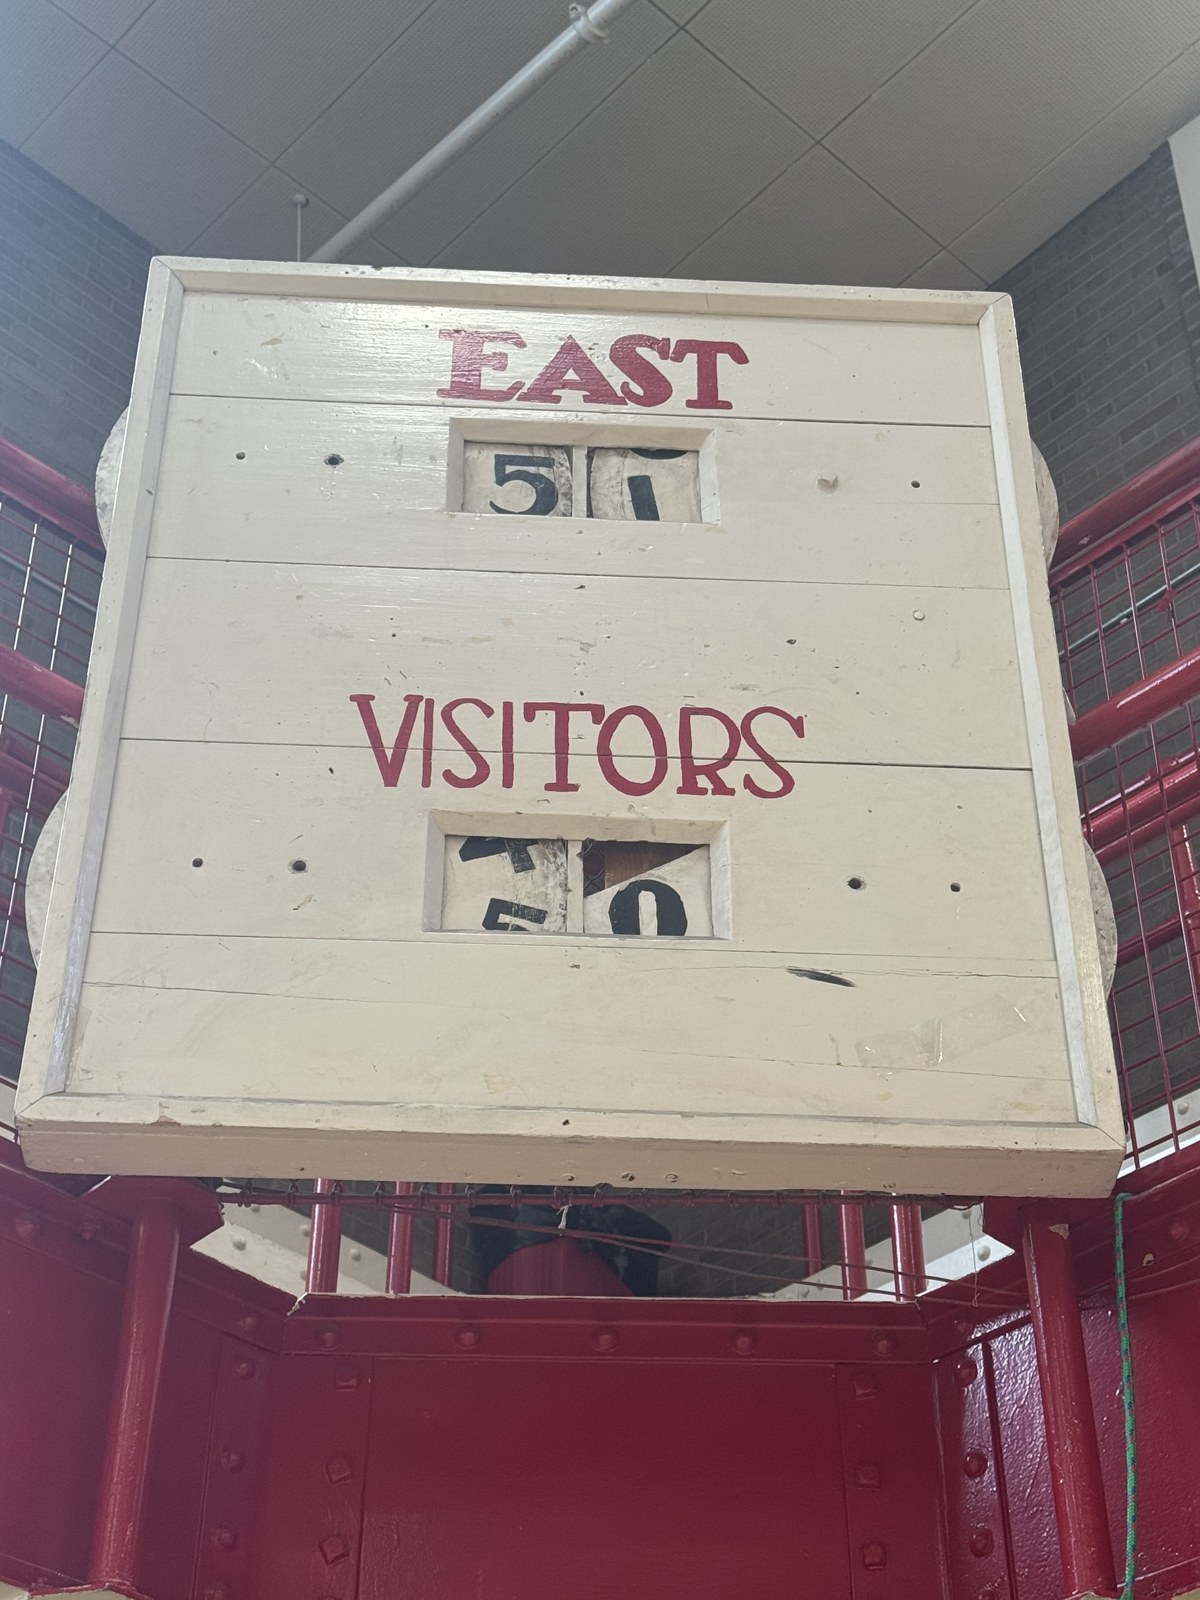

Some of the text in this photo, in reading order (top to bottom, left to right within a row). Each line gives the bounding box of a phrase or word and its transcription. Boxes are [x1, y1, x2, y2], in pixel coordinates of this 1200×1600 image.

[436, 328, 749, 410] EAST
[489, 453, 559, 516] 5
[349, 694, 805, 798] VISITORS
